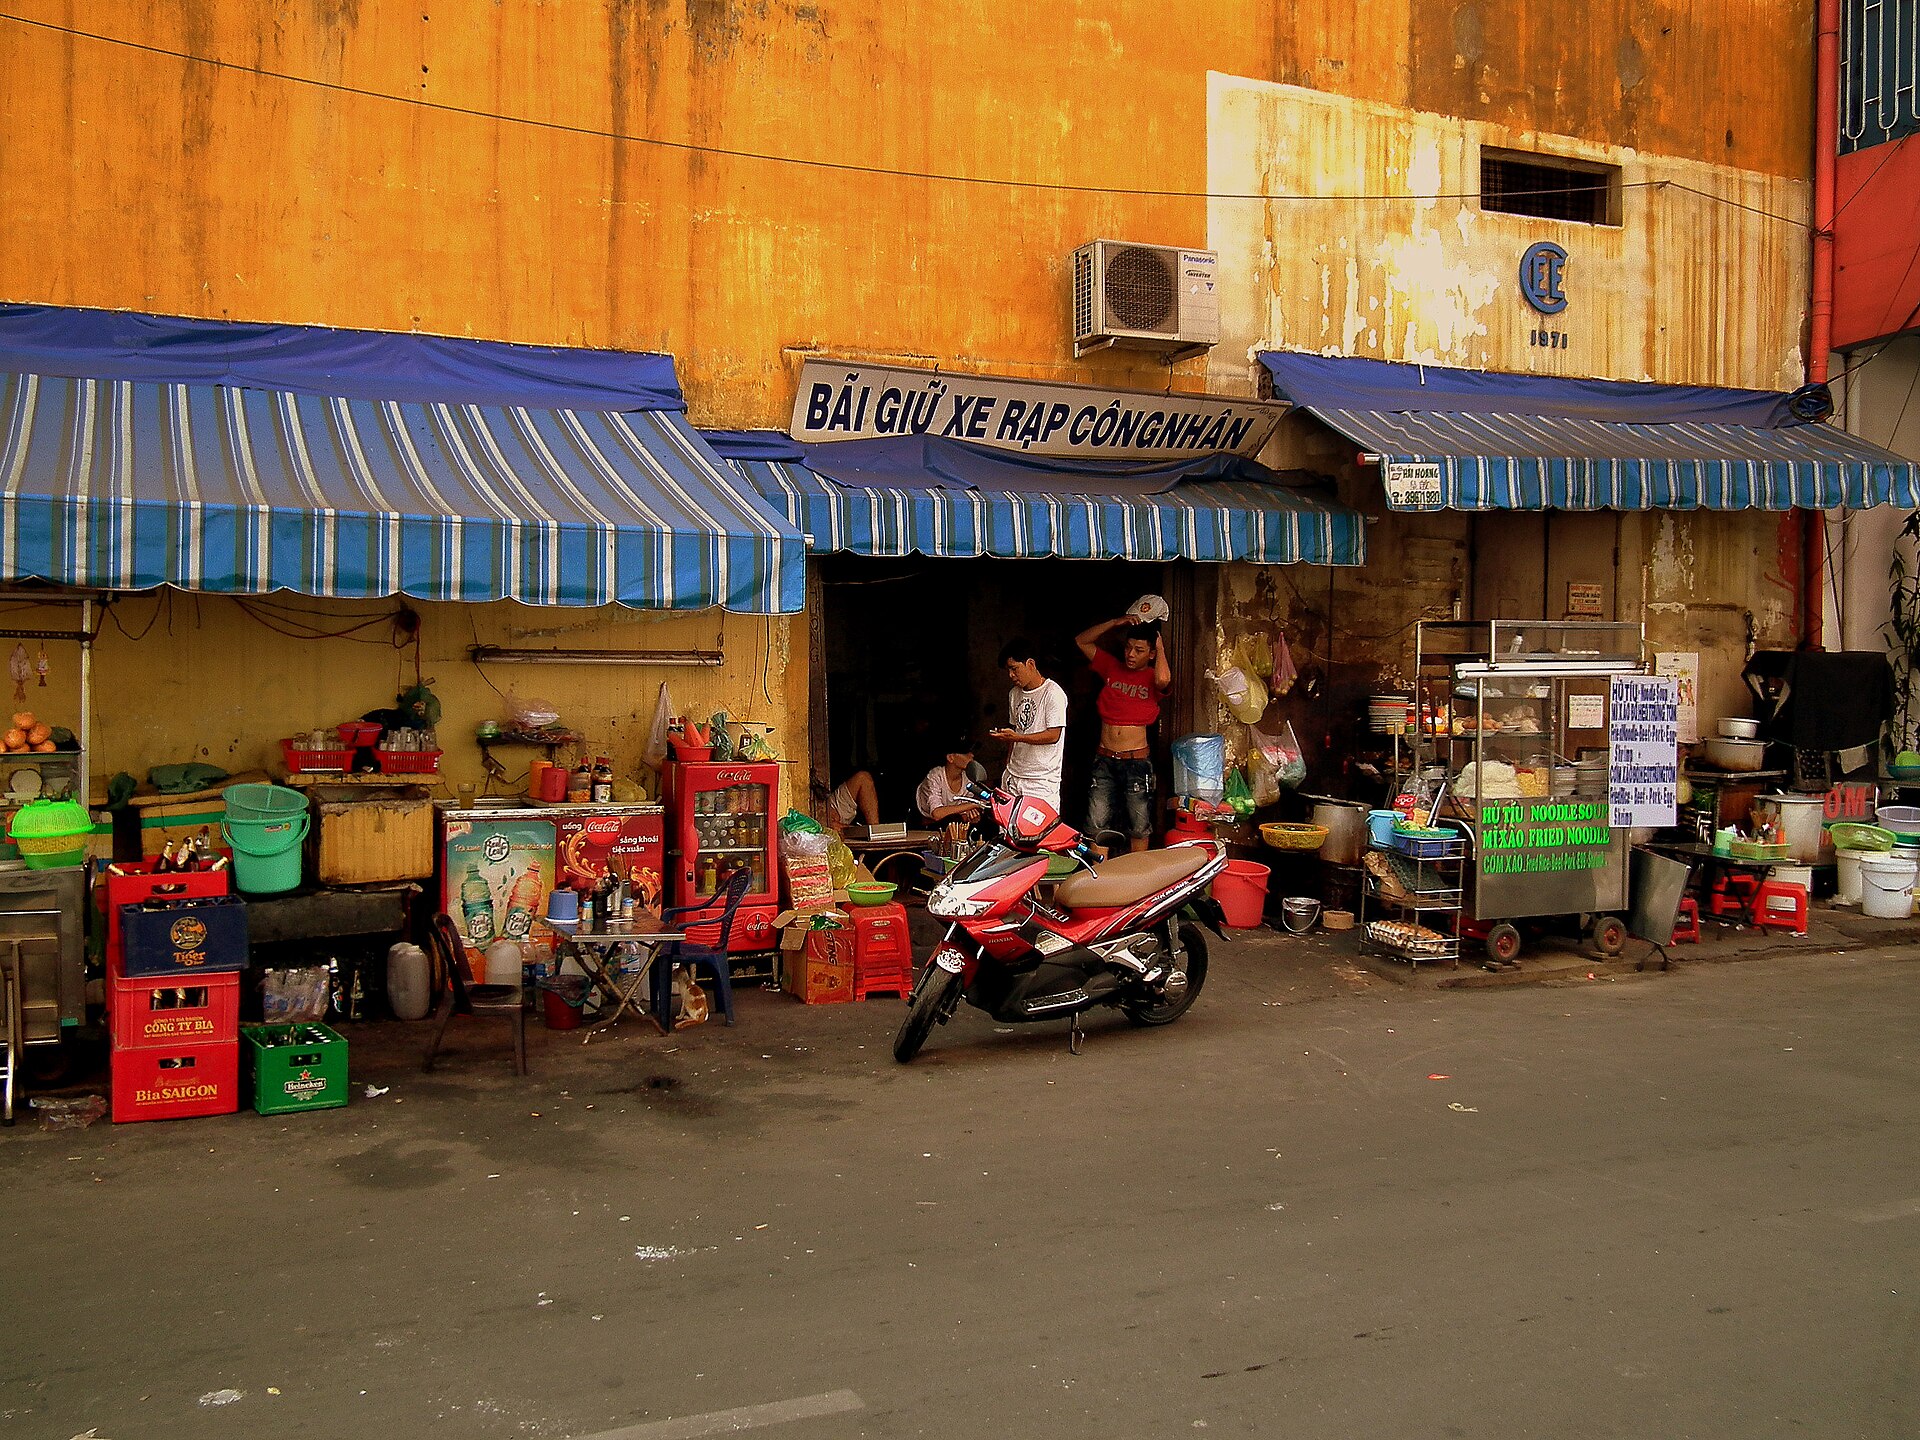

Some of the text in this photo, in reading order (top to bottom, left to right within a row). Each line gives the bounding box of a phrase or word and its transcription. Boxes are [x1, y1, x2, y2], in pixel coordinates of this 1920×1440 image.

[1183, 254, 1215, 264] Panasonic
[1530, 329, 1567, 349] 1971
[804, 372, 870, 432] BÃI
[874, 379, 948, 435] GIỮ
[941, 394, 997, 438] XE
[996, 399, 1070, 450] RẠP
[716, 769, 752, 781] Coca-Cola
[1482, 800, 1500, 824] HỦ
[562, 821, 582, 831] uống
[587, 820, 621, 833] Coca-Cola
[1528, 827, 1564, 848] FRIED
[1566, 826, 1610, 845] NOODLE
[747, 922, 769, 931] Coca-Cola
[825, 930, 838, 966] STING
[173, 950, 206, 963] Tiger
[144, 1020, 214, 1033] CÔNG TY BIA
[136, 1090, 160, 1101] Bia
[162, 1084, 218, 1099] SAIGON
[287, 1081, 324, 1091] Heineken
